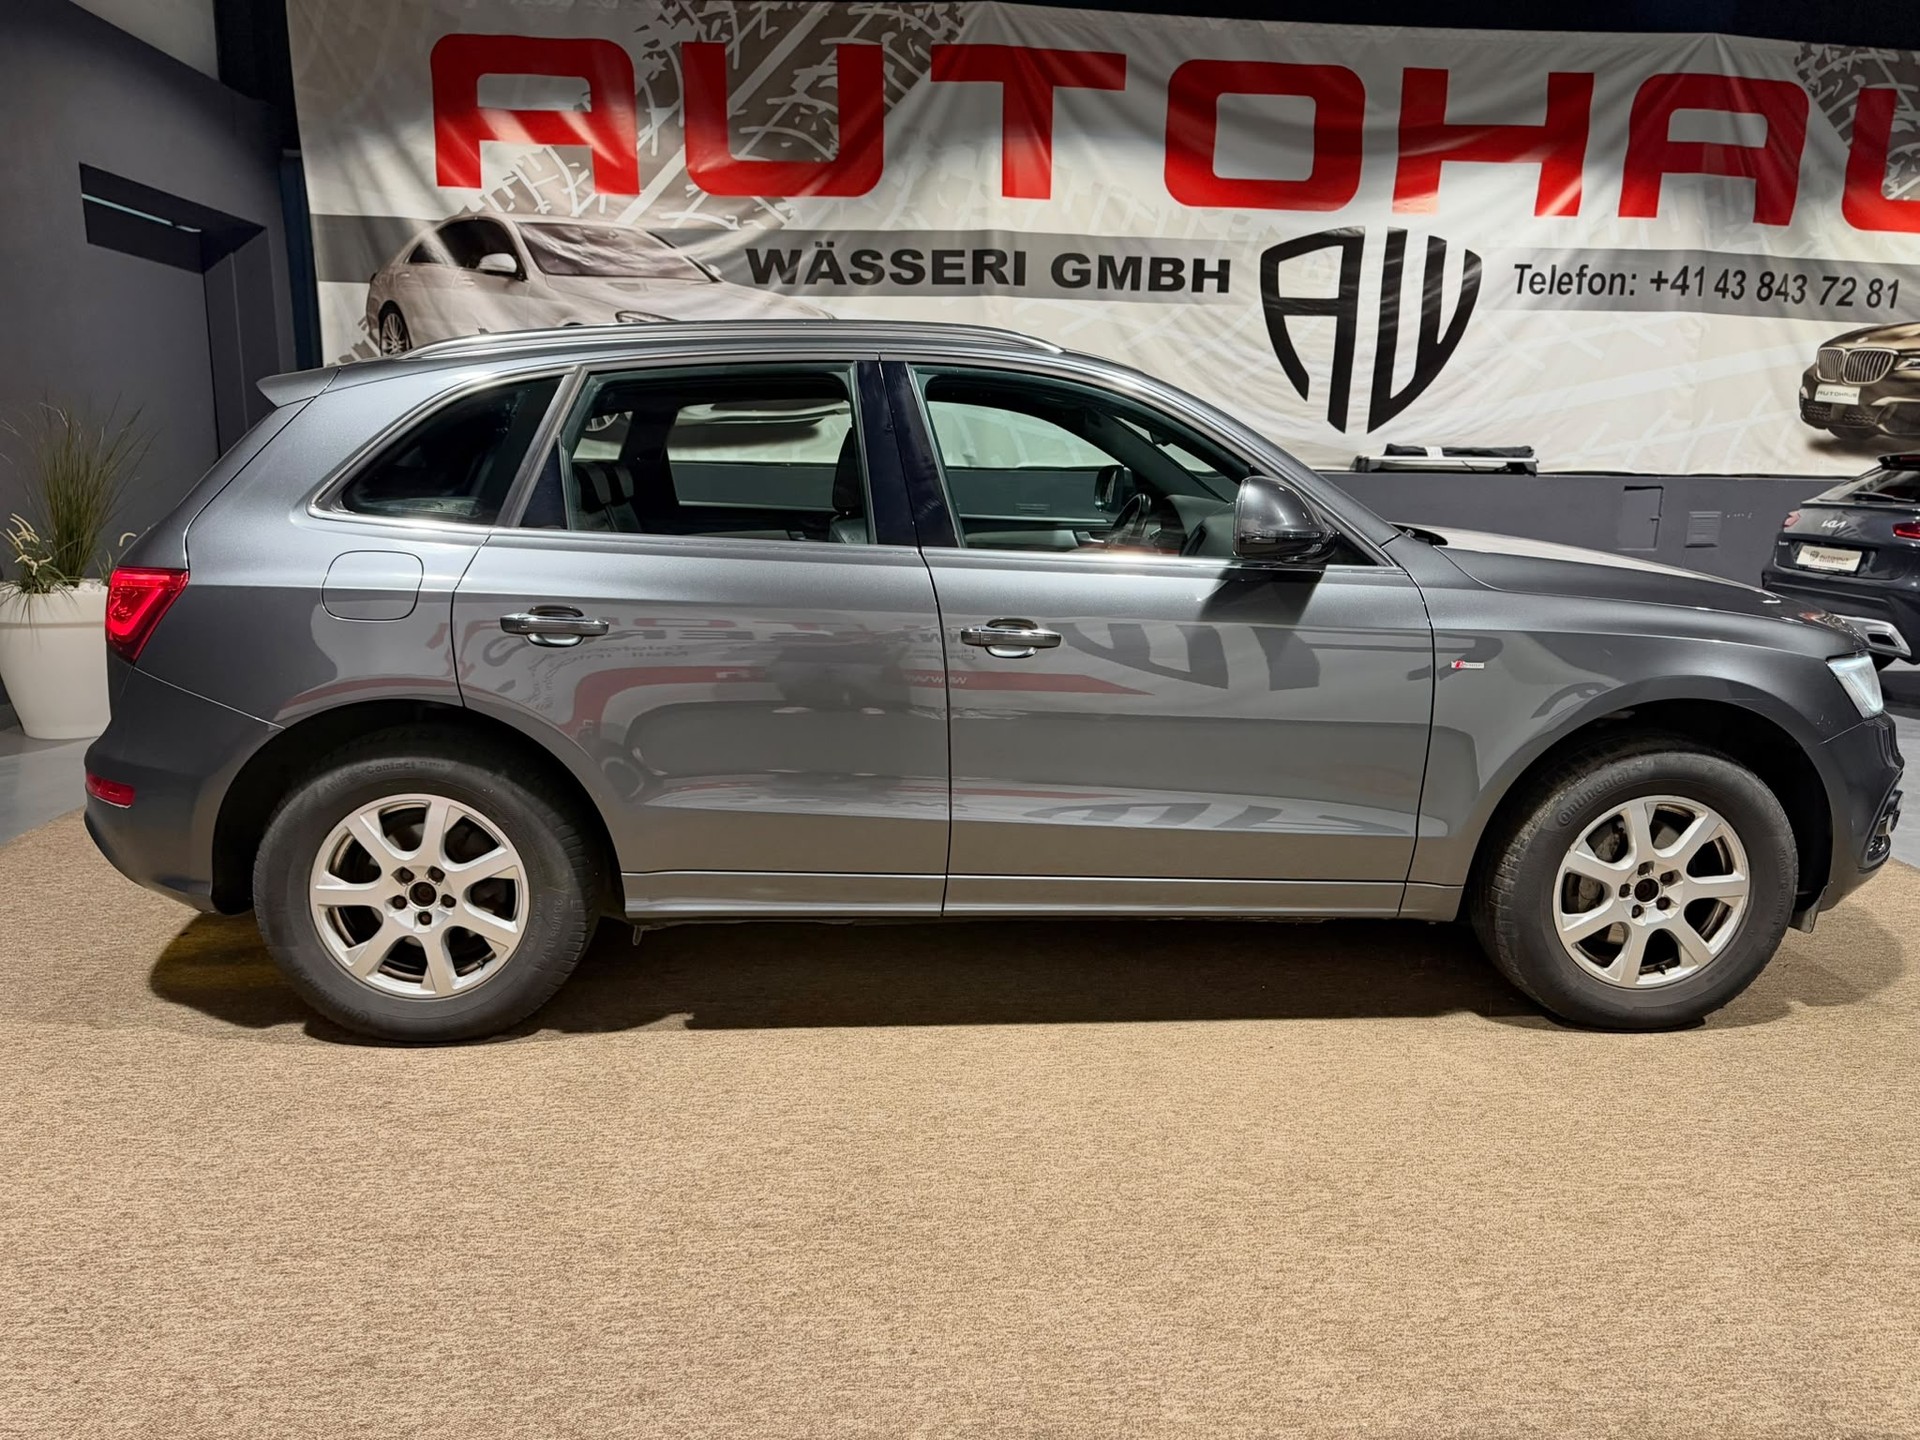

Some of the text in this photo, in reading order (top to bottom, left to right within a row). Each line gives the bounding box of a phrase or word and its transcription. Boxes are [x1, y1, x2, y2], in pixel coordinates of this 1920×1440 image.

[744, 241, 1231, 294] WÄSSERI GMBH
[1513, 263, 1901, 310] Telefon: +41 43 843 72 81
